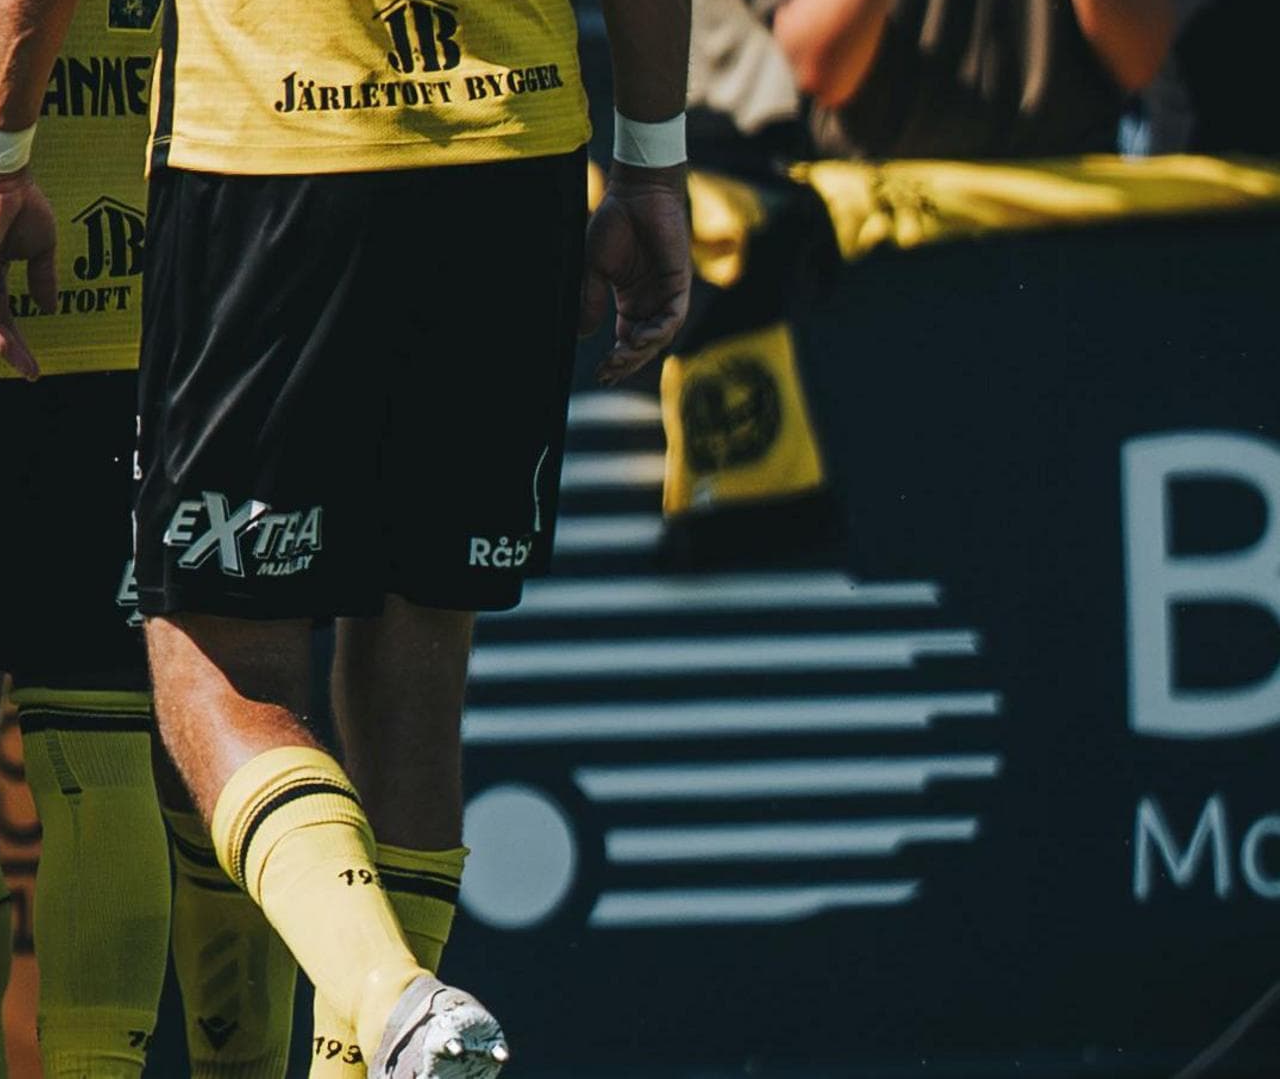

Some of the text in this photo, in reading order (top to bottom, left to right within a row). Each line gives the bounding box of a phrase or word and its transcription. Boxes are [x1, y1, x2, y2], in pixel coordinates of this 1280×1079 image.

[41, 55, 152, 118] ANNE
[274, 63, 563, 114] JÄRLETOFT BYGGER
